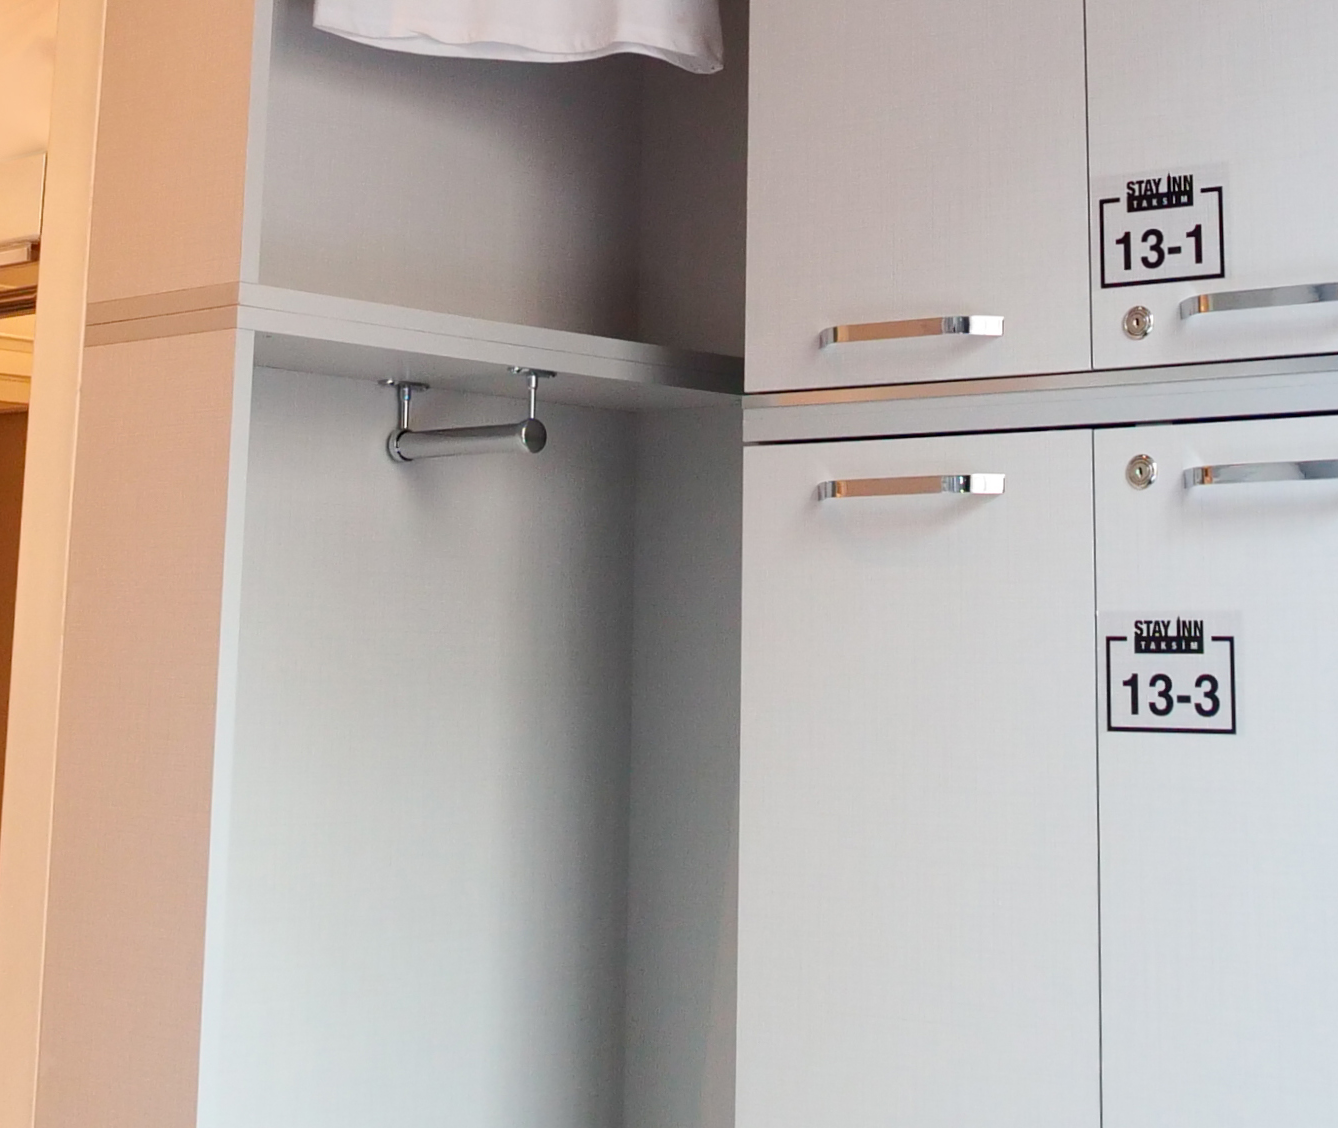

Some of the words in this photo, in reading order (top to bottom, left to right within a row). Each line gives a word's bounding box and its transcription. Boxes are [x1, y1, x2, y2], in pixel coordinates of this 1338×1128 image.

[1126, 178, 1162, 197] STAY
[1115, 223, 1203, 271] 13-1
[1134, 620, 1171, 637] STAY
[1122, 673, 1221, 718] 13-3
